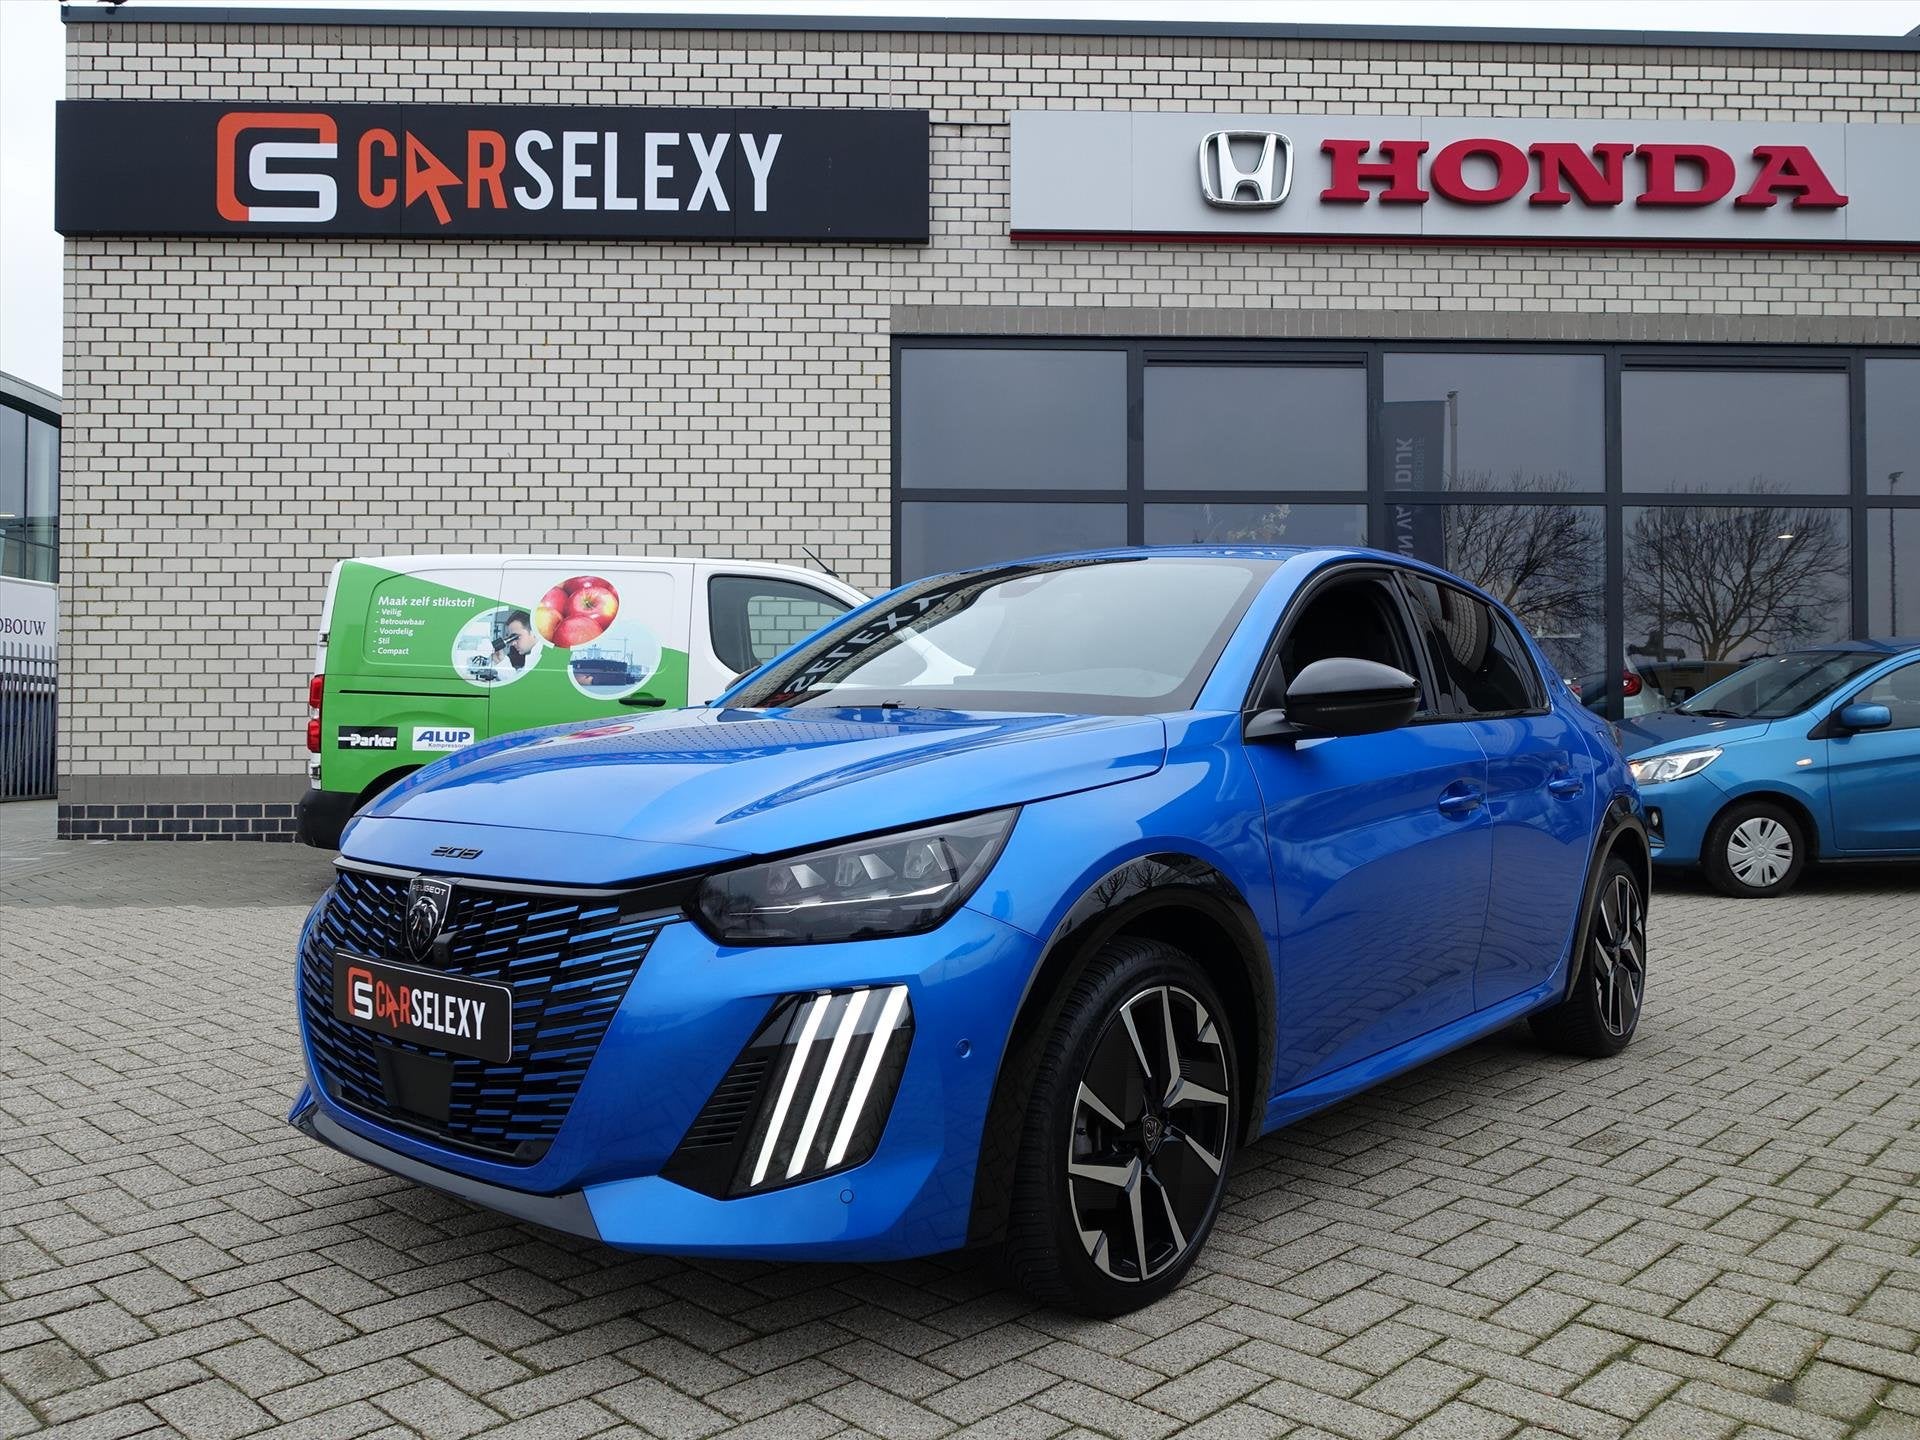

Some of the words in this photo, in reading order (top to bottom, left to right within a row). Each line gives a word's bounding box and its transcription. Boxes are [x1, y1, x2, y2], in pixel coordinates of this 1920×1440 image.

[358, 128, 783, 225] CARSELEXY
[1320, 139, 1849, 208] HONDA
[378, 596, 408, 606] Maak
[410, 597, 430, 607] zelf
[432, 597, 475, 608] stikstof!
[382, 608, 402, 617] Veilig
[380, 618, 425, 626] Betrouwbaar
[380, 628, 414, 637] Voordelig
[377, 647, 409, 656] Compact
[349, 733, 397, 748] Parker
[416, 730, 471, 743] ALUP
[431, 846, 484, 860] 208
[412, 884, 446, 896] PEUGEOT
[375, 979, 486, 1041] CARSELEXY
